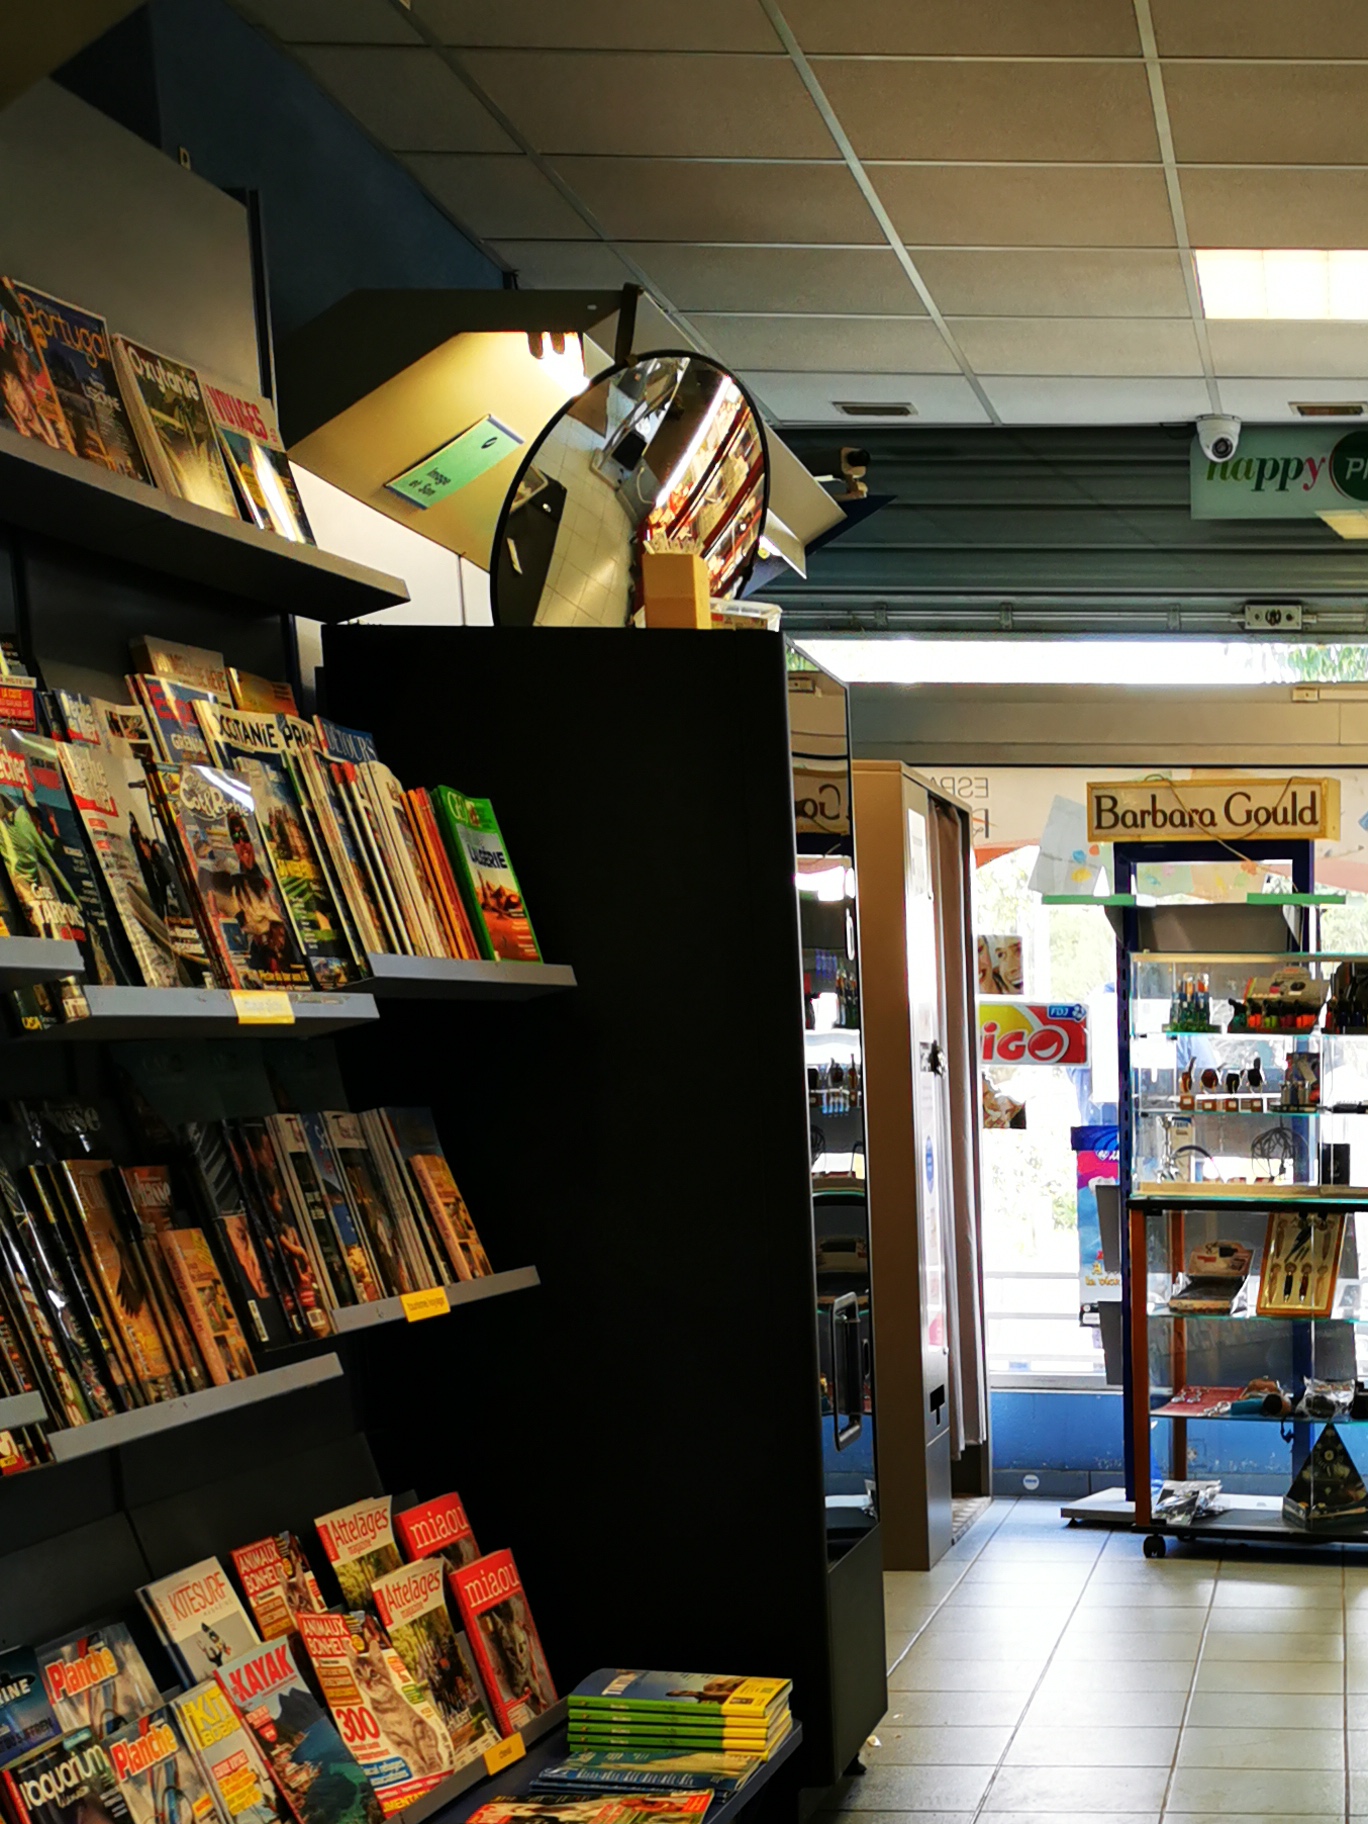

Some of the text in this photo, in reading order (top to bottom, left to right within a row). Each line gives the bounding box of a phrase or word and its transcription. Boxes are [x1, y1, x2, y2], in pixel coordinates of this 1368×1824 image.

[126, 346, 200, 401] Oxytanie
[1094, 790, 1320, 830] Barbara Gould
[1050, 1005, 1071, 1018] FDJ
[330, 1507, 389, 1547] Attelages
[409, 1504, 469, 1550] miaou
[237, 1543, 281, 1573] ANIMAUX
[167, 1571, 226, 1622] KITESURF
[384, 1570, 441, 1611] Attelages
[464, 1562, 520, 1609] miaou
[303, 1617, 349, 1637] ANIMAUX
[45, 1646, 118, 1701] Planche
[229, 1643, 295, 1704] KAYAK
[335, 1706, 381, 1744] 300
[109, 1722, 179, 1781] Planche
